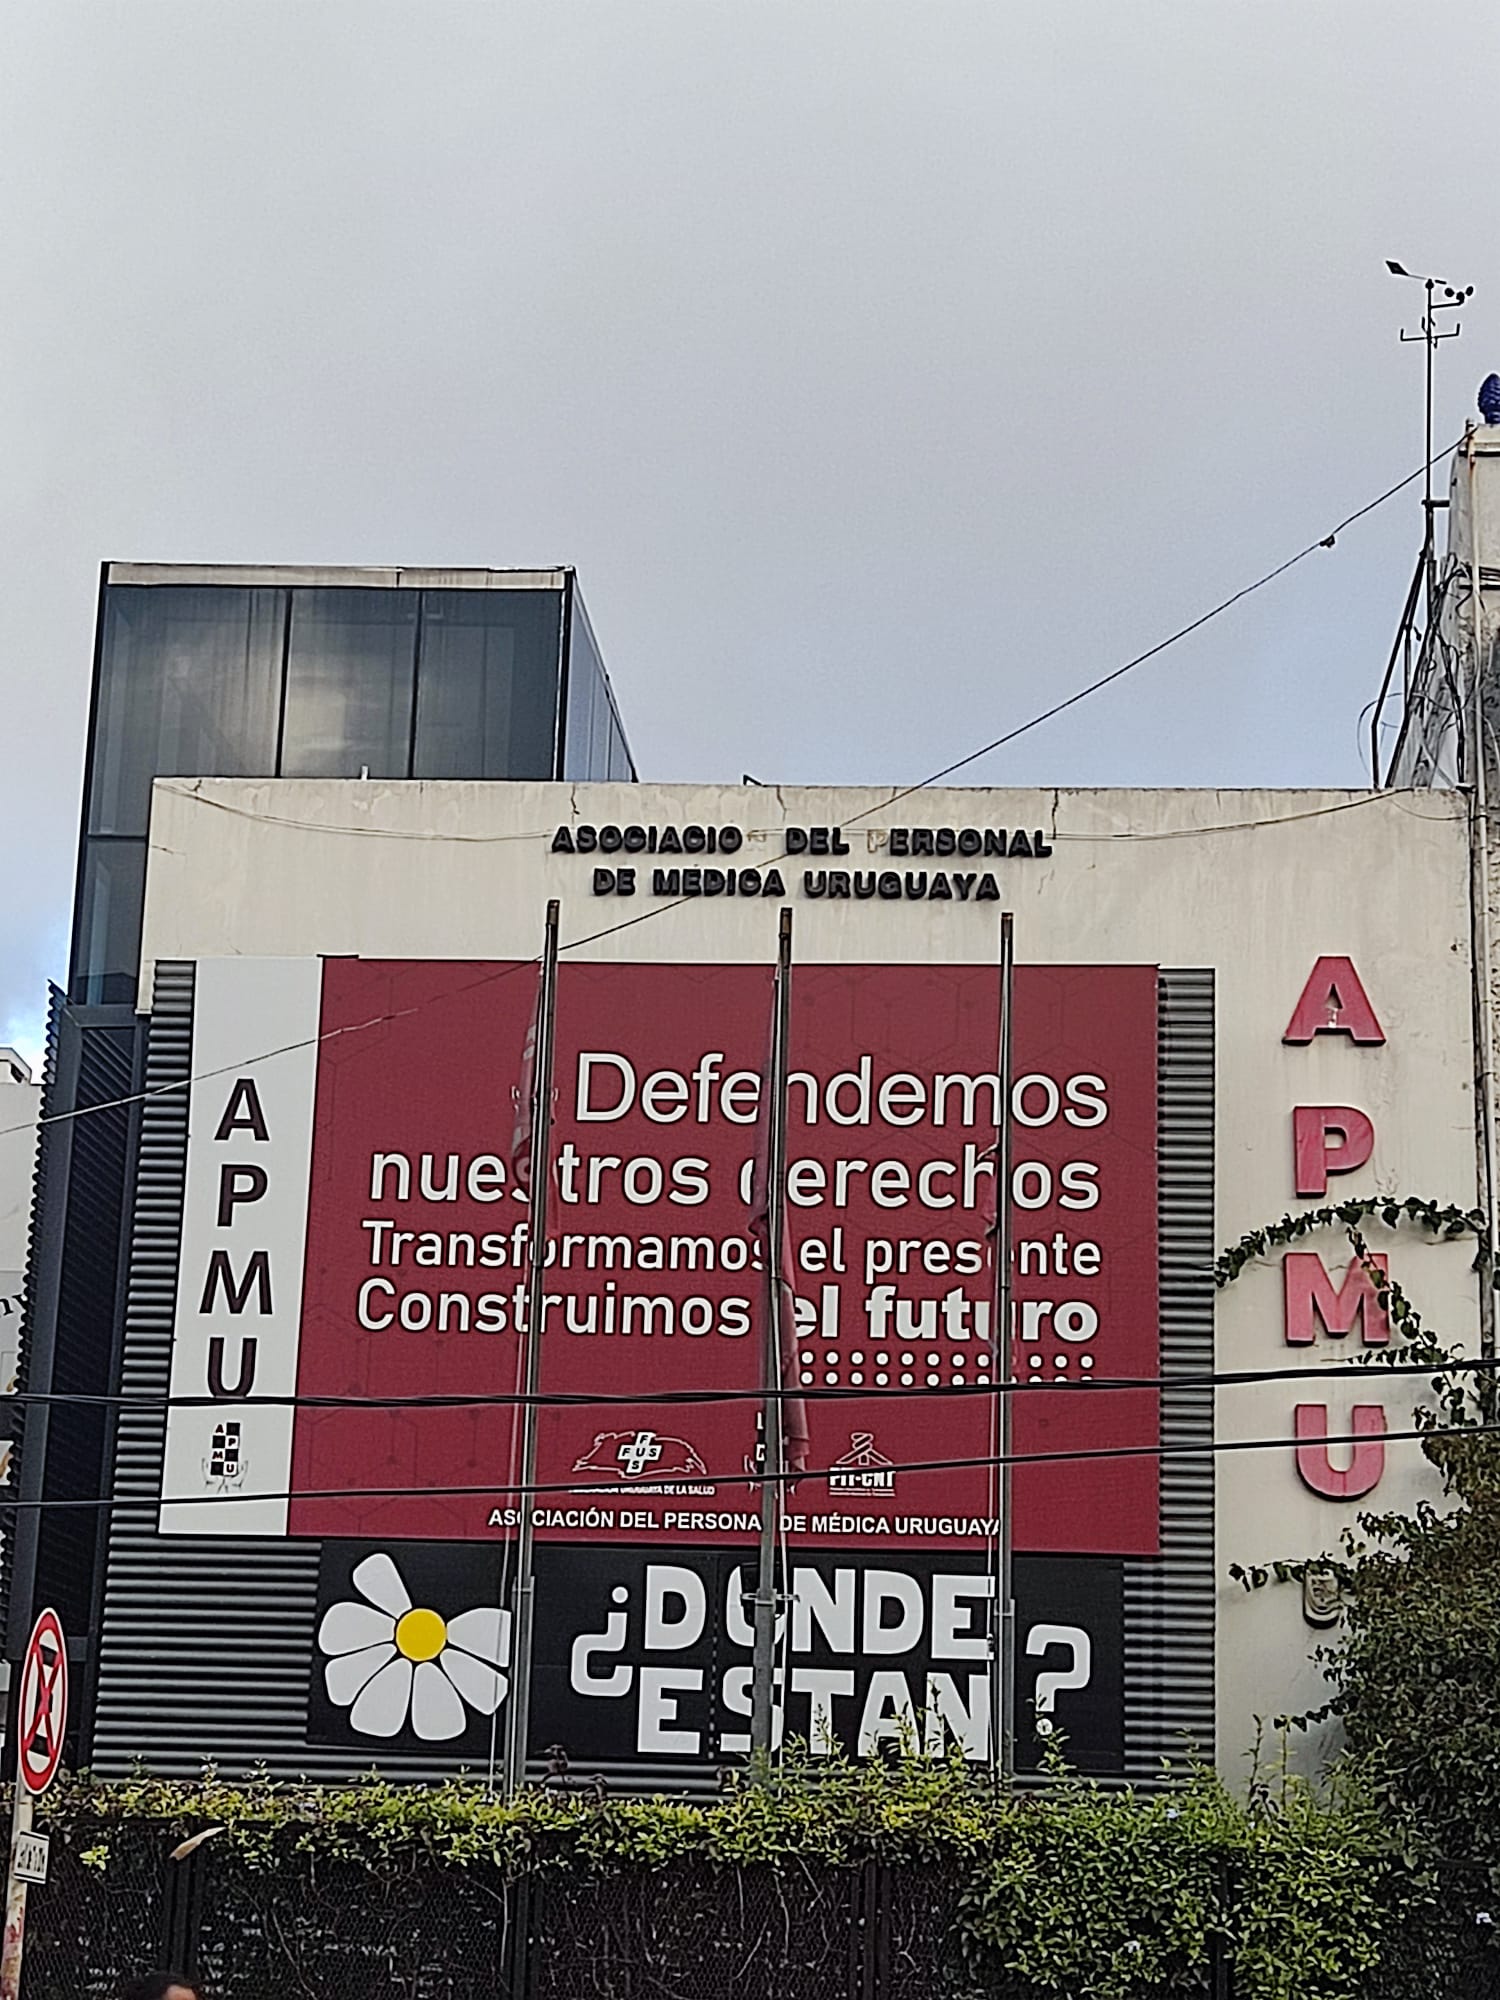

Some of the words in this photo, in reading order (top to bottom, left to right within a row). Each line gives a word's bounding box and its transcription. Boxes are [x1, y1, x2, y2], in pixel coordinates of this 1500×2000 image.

[785, 827, 850, 855] DEL
[593, 868, 636, 896] DE
[652, 869, 785, 897] MEDICA
[804, 871, 999, 900] URUGUAYA
[577, 1051, 1108, 1127] Defendemos
[370, 1144, 709, 1204] nuetros
[740, 1143, 1100, 1210] erechos
[800, 1228, 846, 1273] el
[864, 1232, 1101, 1284] presnte
[357, 1278, 750, 1336] Construimos
[488, 1507, 614, 1528] ASCIACIÓN
[620, 1511, 659, 1528] DEL
[664, 1512, 763, 1531] PERSONA
[780, 1515, 806, 1532] DE
[812, 1512, 890, 1534] MÉDICA
